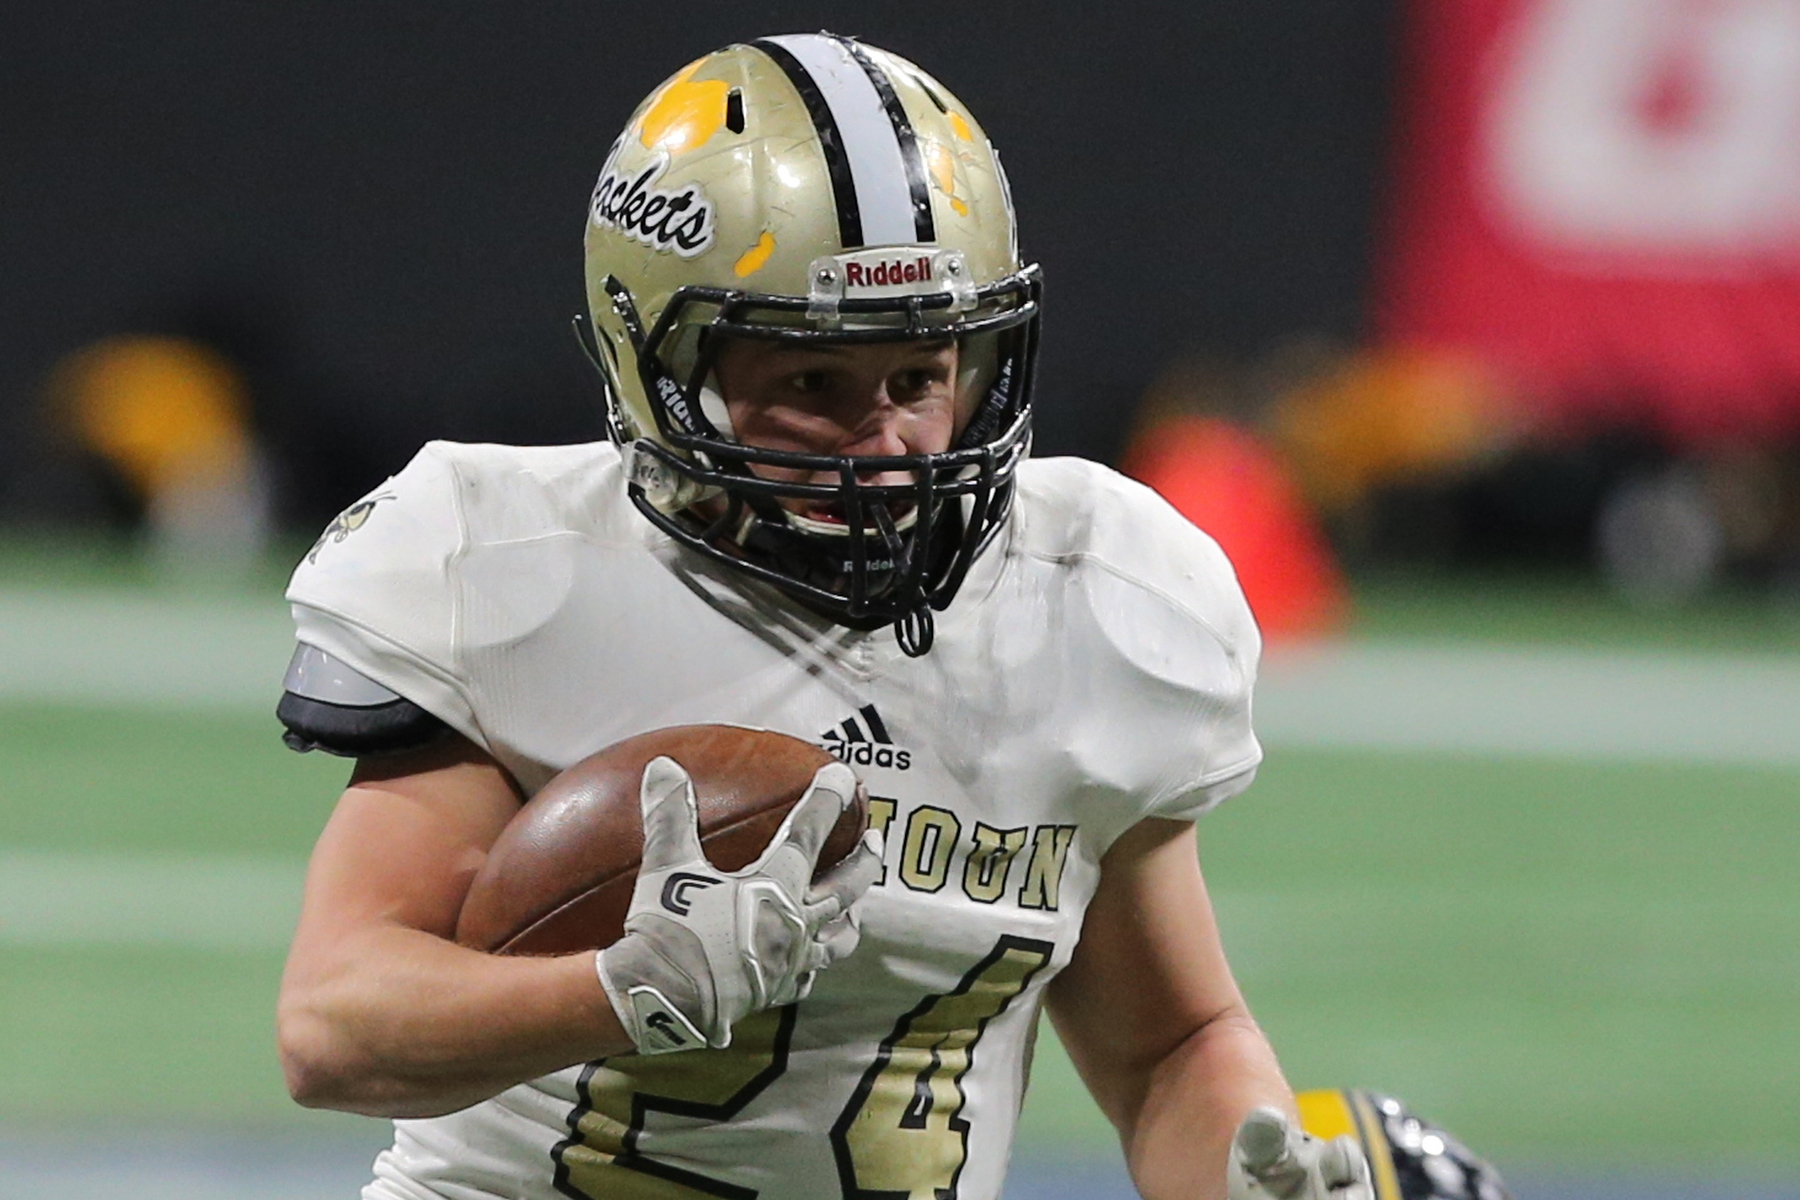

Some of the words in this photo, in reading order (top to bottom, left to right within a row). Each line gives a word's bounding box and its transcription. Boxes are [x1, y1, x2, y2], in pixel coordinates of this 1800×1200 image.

[593, 140, 708, 250] ackets
[846, 256, 931, 287] Riddell
[818, 741, 911, 770] didas
